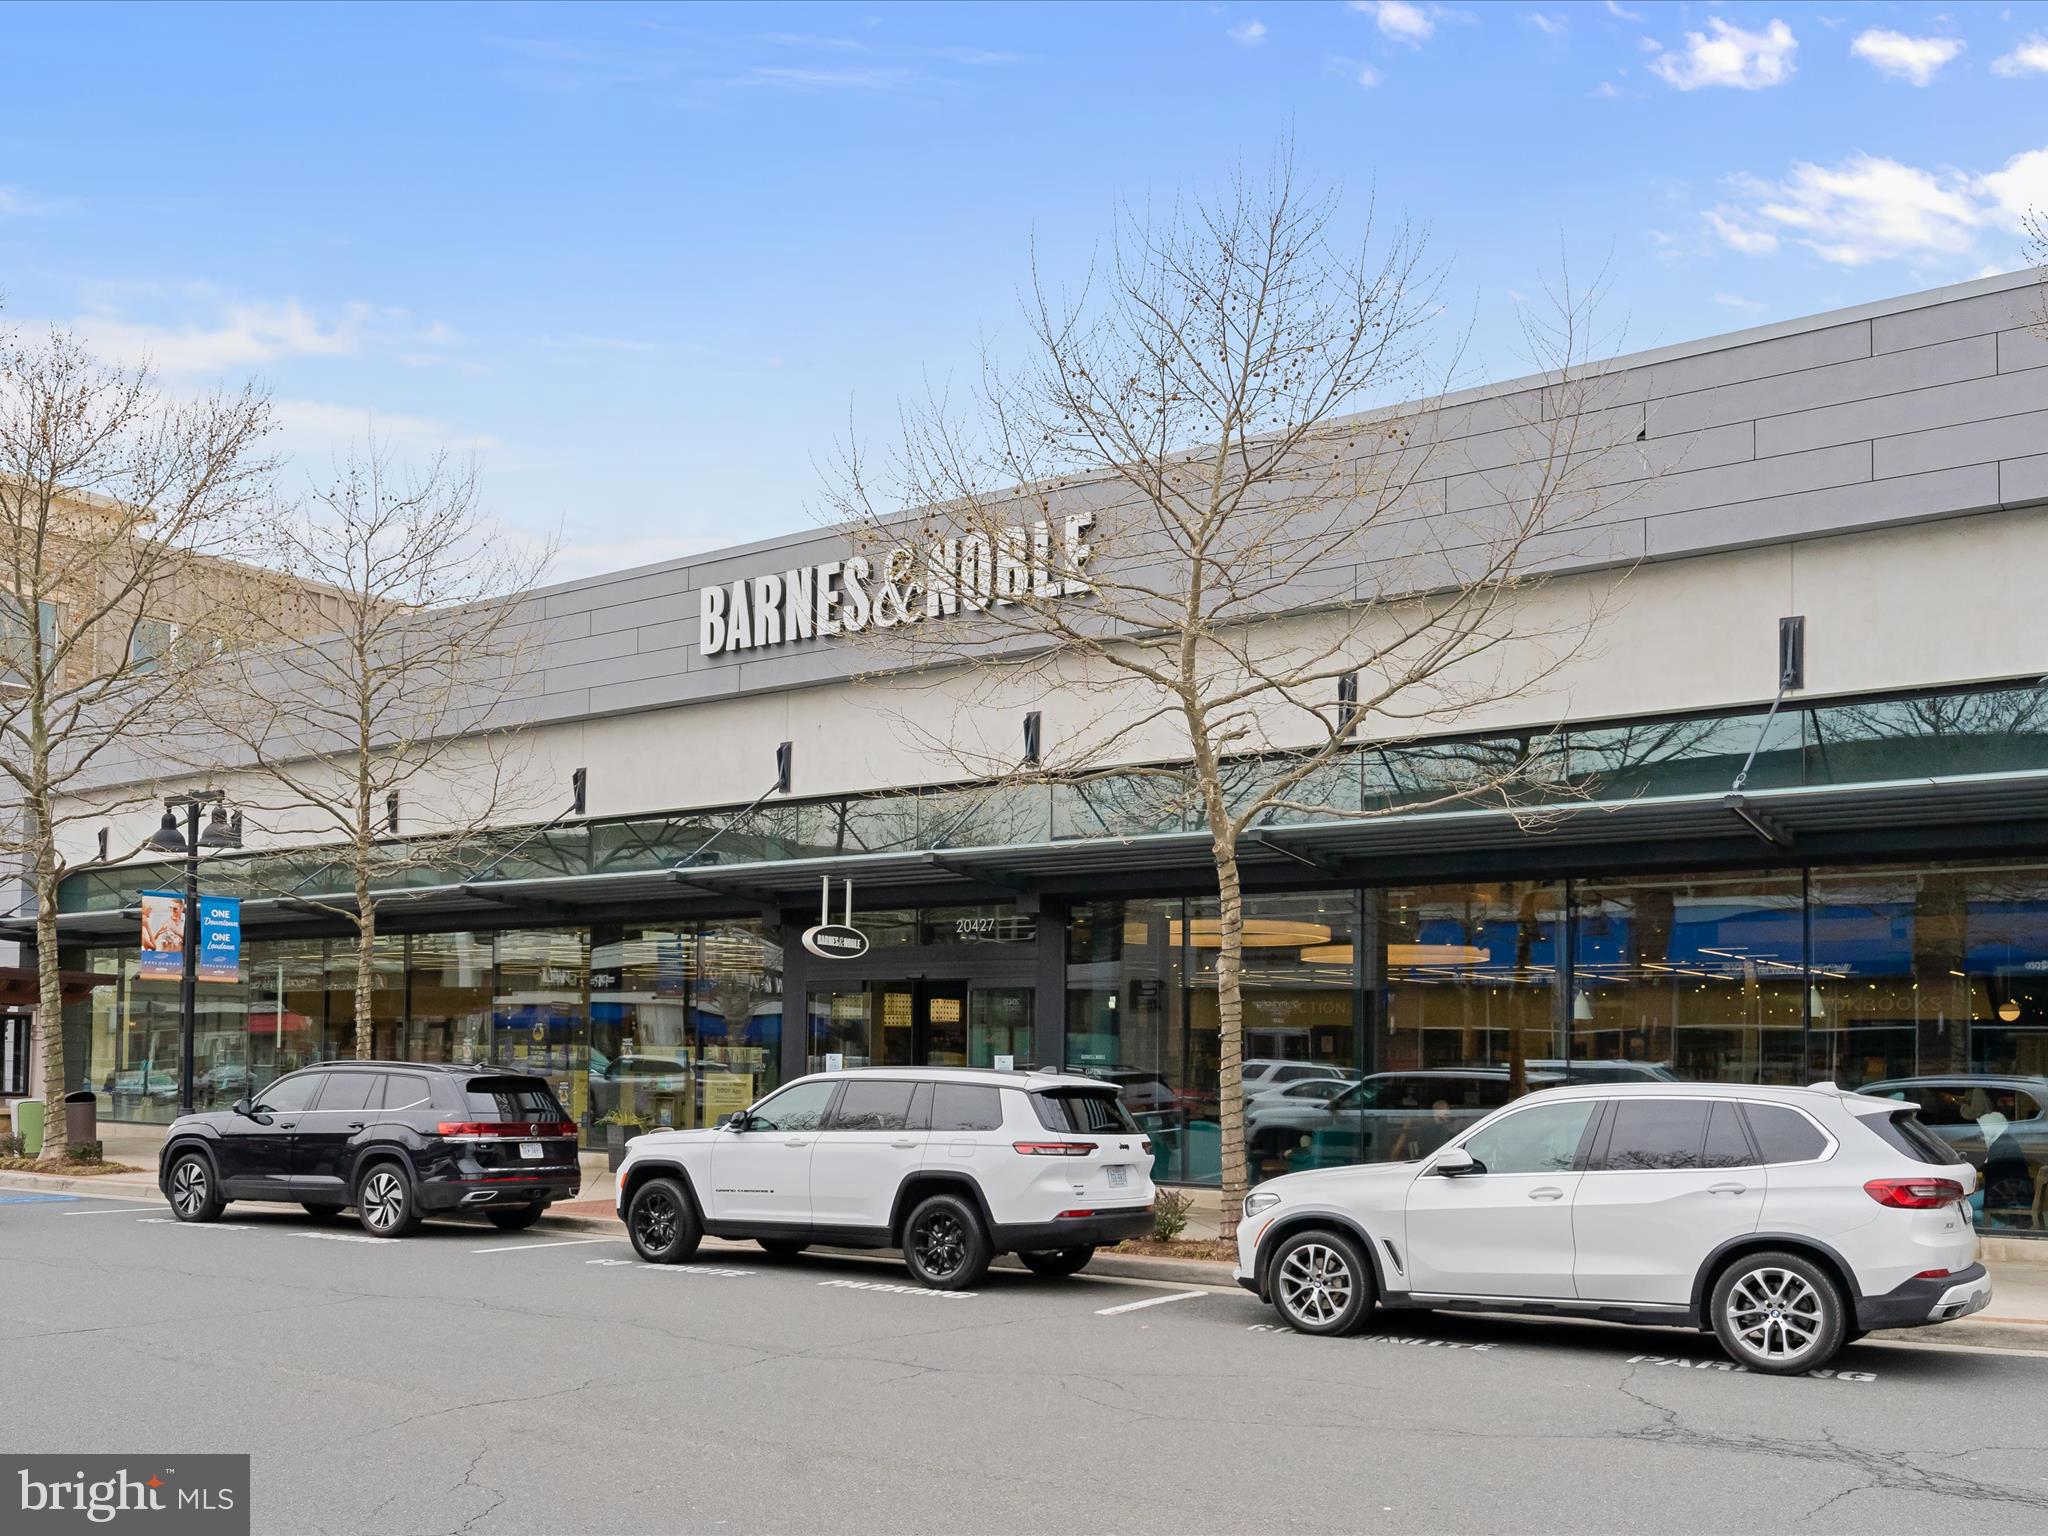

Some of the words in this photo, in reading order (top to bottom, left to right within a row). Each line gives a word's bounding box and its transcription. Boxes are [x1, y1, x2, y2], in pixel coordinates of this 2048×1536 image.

[211, 909, 231, 919] ONE
[956, 918, 995, 933] 20427
[211, 932, 231, 942] ONE
[817, 1279, 979, 1299] PARKING
[1624, 1354, 1878, 1382] PARNG
